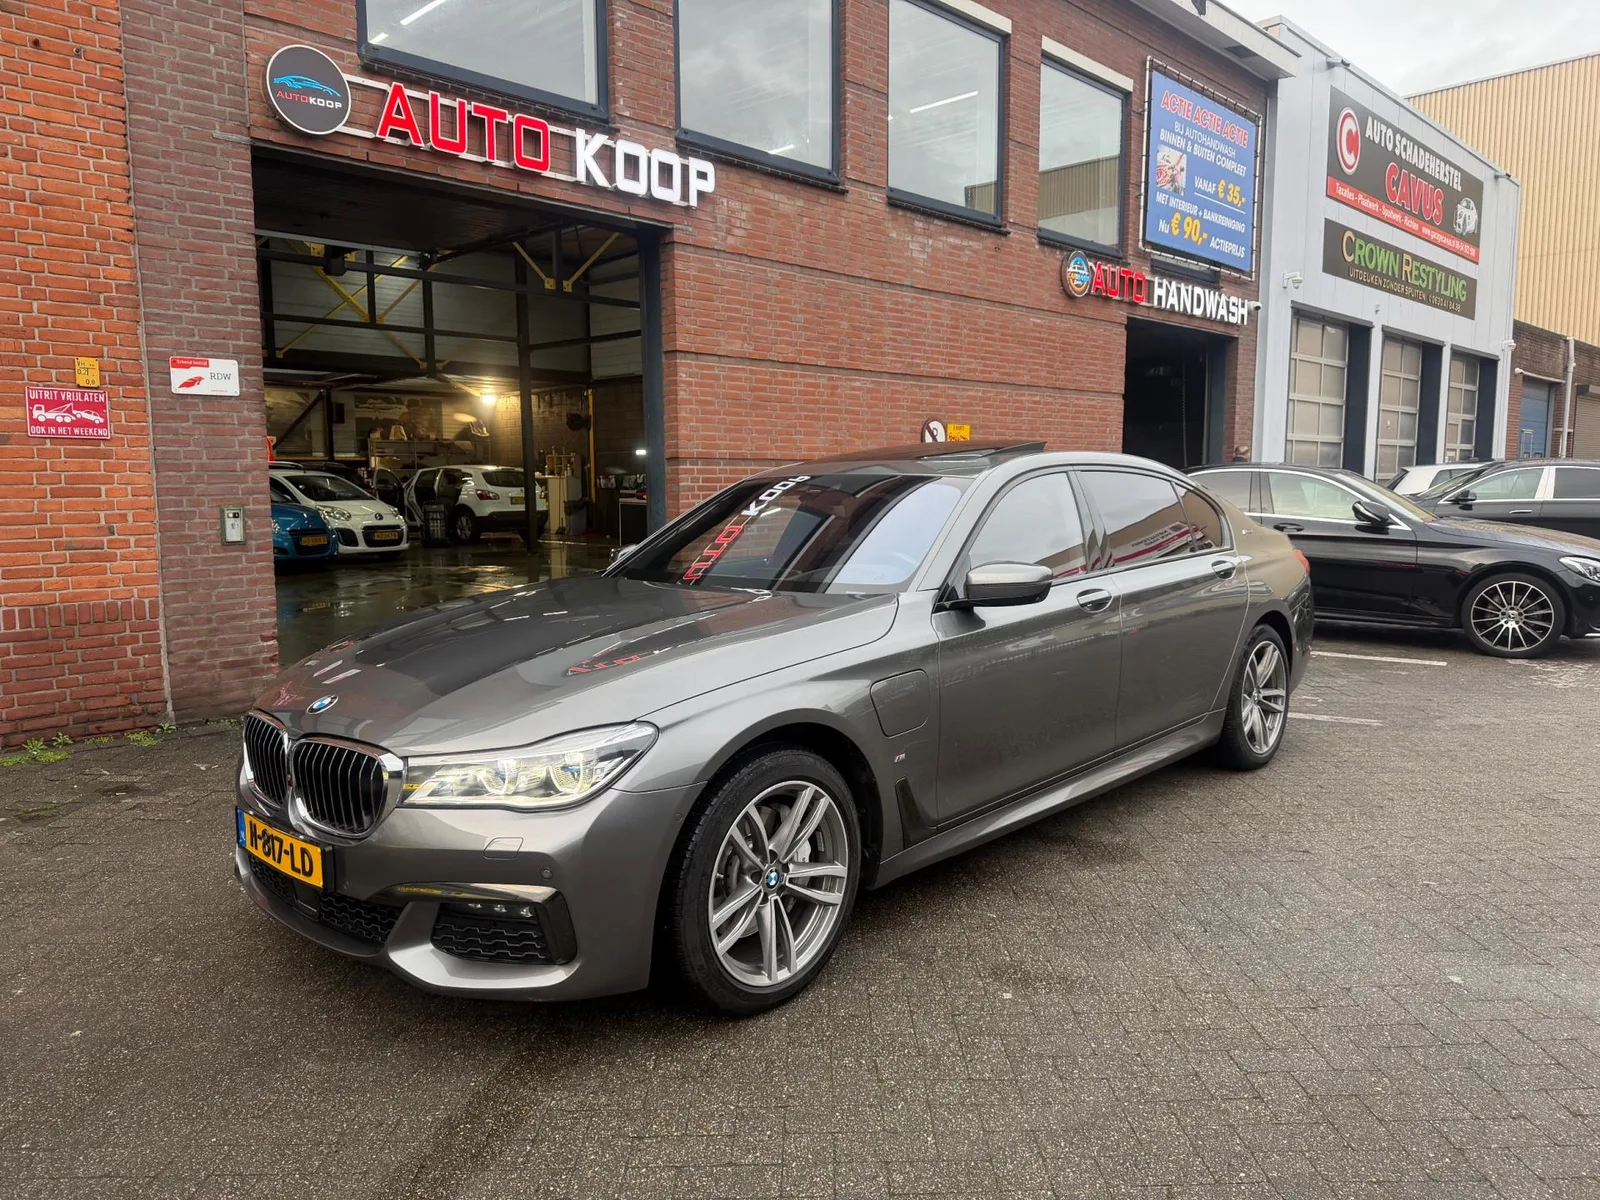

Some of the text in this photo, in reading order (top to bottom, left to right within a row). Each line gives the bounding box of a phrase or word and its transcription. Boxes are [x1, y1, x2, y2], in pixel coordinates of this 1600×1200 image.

[1160, 89, 1249, 149] ACTIE ACTIE ACTIE
[1174, 121, 1236, 158] BIJ AUTOHANDWASH
[376, 81, 716, 209] AUTO KOOP
[1160, 128, 1247, 177] BINNEN & BUITEN COMPLEET
[1365, 116, 1463, 192] AUTO SCHADEHERSTEL
[1194, 175, 1217, 194] VANAF
[1385, 161, 1445, 226] CAVUS
[1156, 191, 1168, 205] MET
[1169, 197, 1198, 217] INTERIEUR
[1203, 208, 1245, 233] BANKREINIGING
[1209, 236, 1245, 258] ACTIEPRIJS
[1342, 230, 1467, 302] CROWN RESTYLING
[1091, 261, 1248, 326] AUTO HANDWASH
[1349, 266, 1383, 286] UITDEUKEN
[1382, 277, 1405, 295] ZONDER
[29, 390, 105, 403] UITRIT VRIJLATEN
[209, 372, 232, 381] RDW
[31, 425, 107, 436] OOK IN HET WEEKEND
